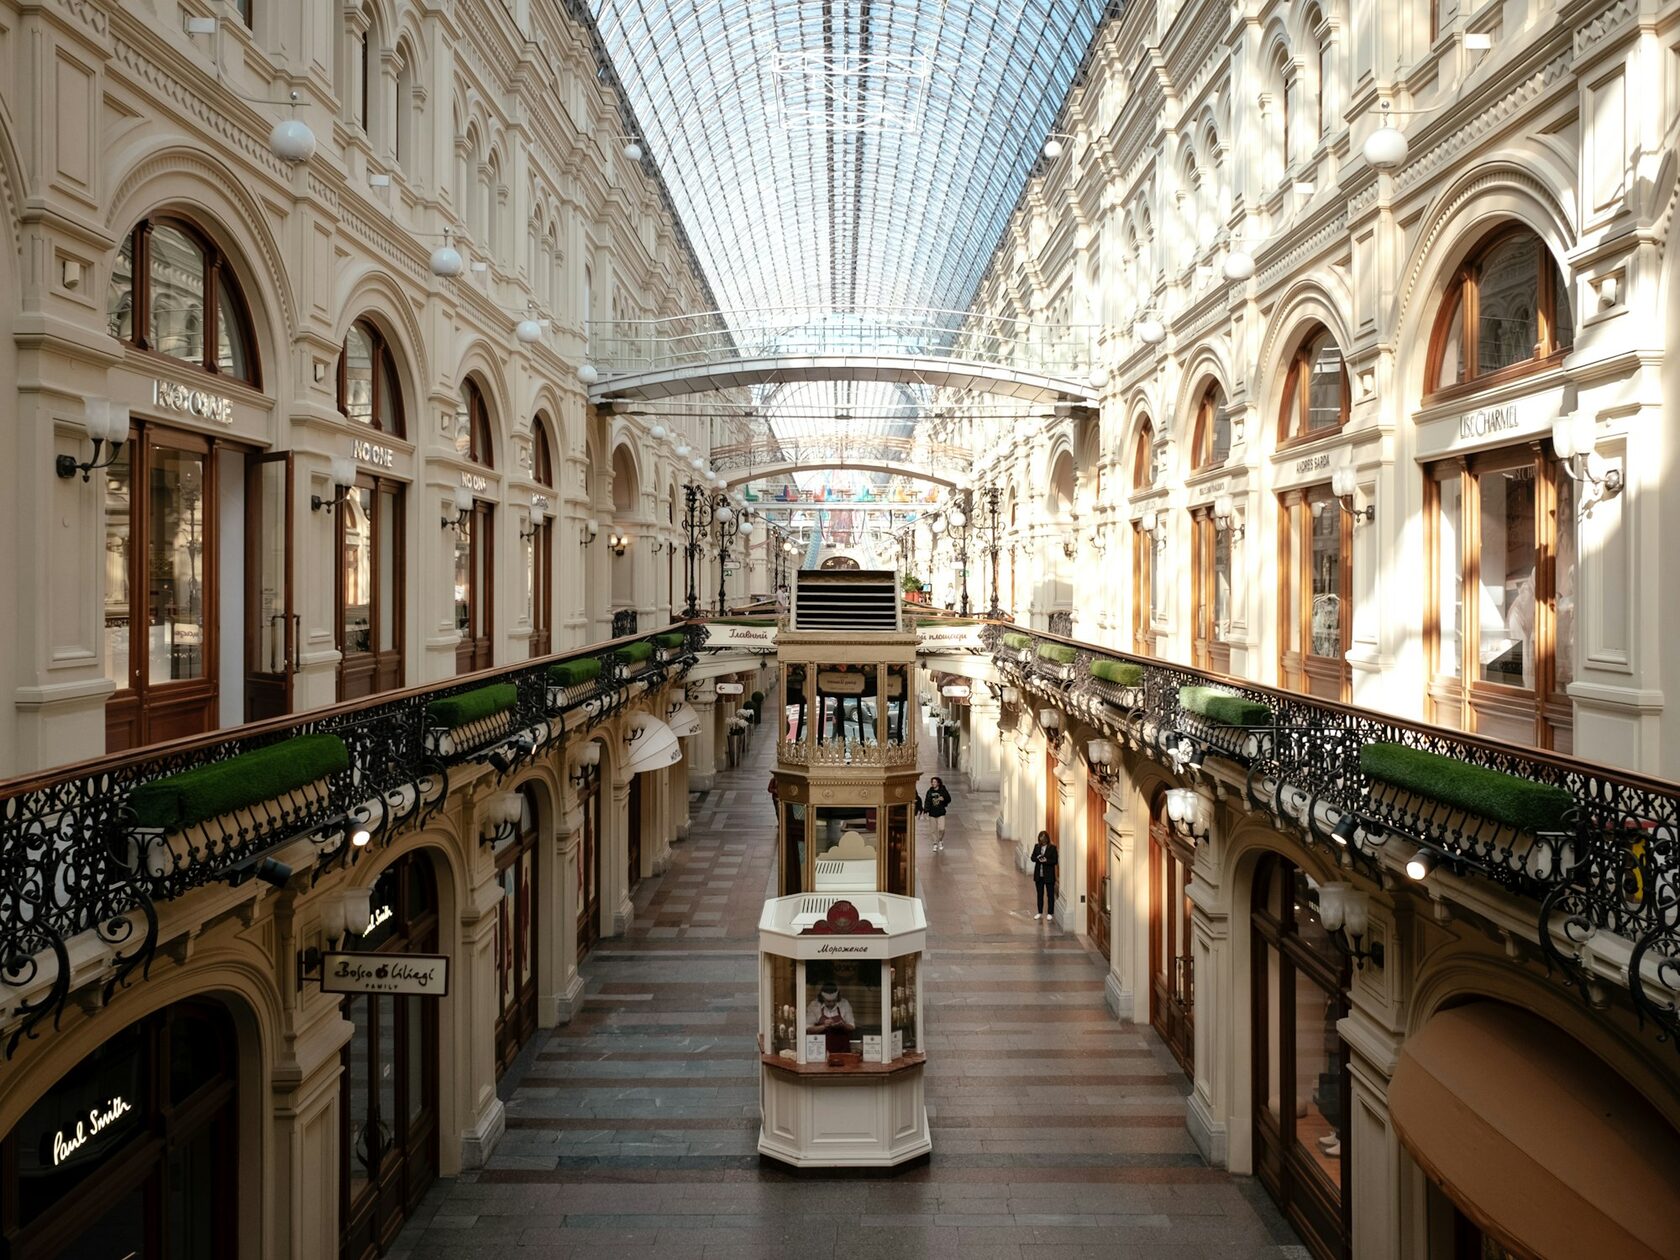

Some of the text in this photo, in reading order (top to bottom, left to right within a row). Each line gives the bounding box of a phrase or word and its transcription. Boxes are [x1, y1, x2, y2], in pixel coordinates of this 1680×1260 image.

[153, 379, 234, 424] NO ONE
[352, 439, 393, 467] NO ONE
[461, 471, 472, 488] NO
[728, 628, 768, 640] Главный
[817, 943, 869, 955] Мороженое
[334, 961, 373, 982] Bosco
[365, 983, 398, 991] FAMILY
[53, 1096, 132, 1166] Paul Smith
